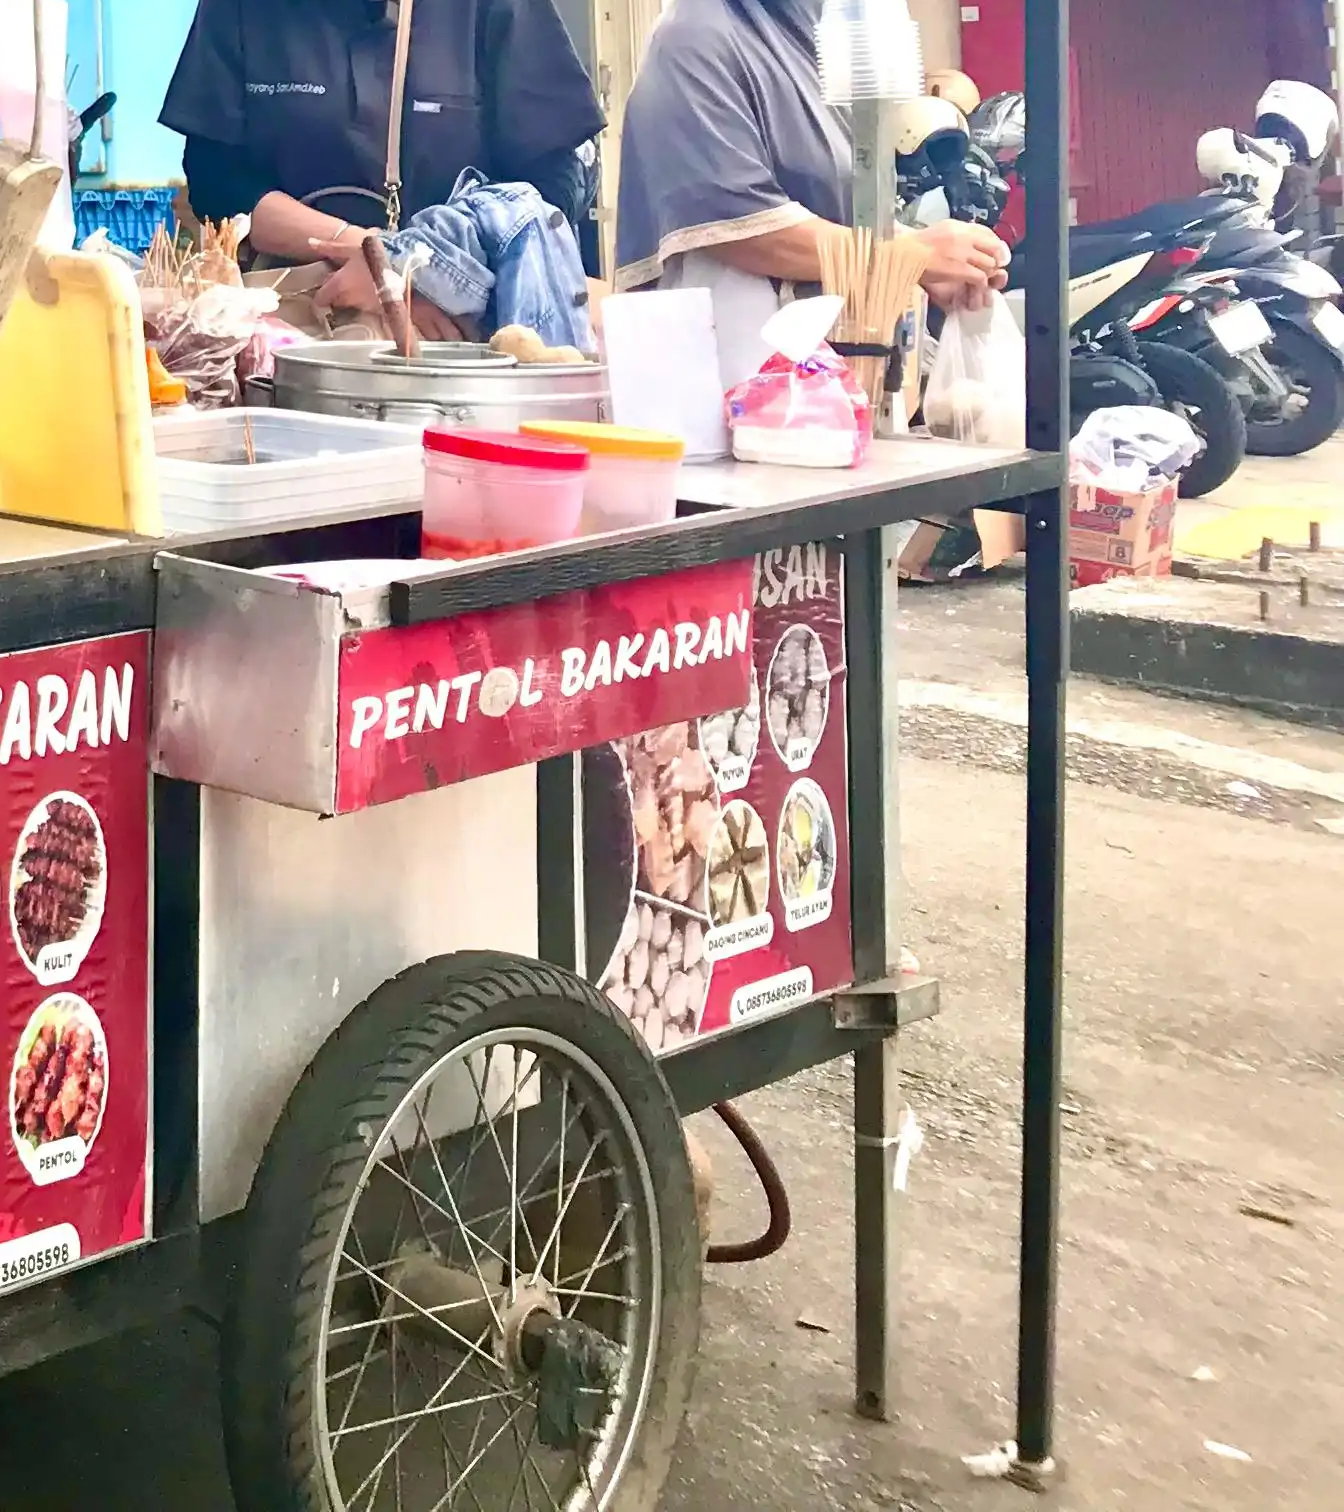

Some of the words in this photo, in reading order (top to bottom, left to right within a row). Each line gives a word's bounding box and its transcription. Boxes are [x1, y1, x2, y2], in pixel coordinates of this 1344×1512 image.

[350, 658, 543, 748] PENTOL
[560, 609, 750, 697] BAKARAN
[44, 953, 73, 970] KULIT
[39, 1148, 78, 1170] PENTOL
